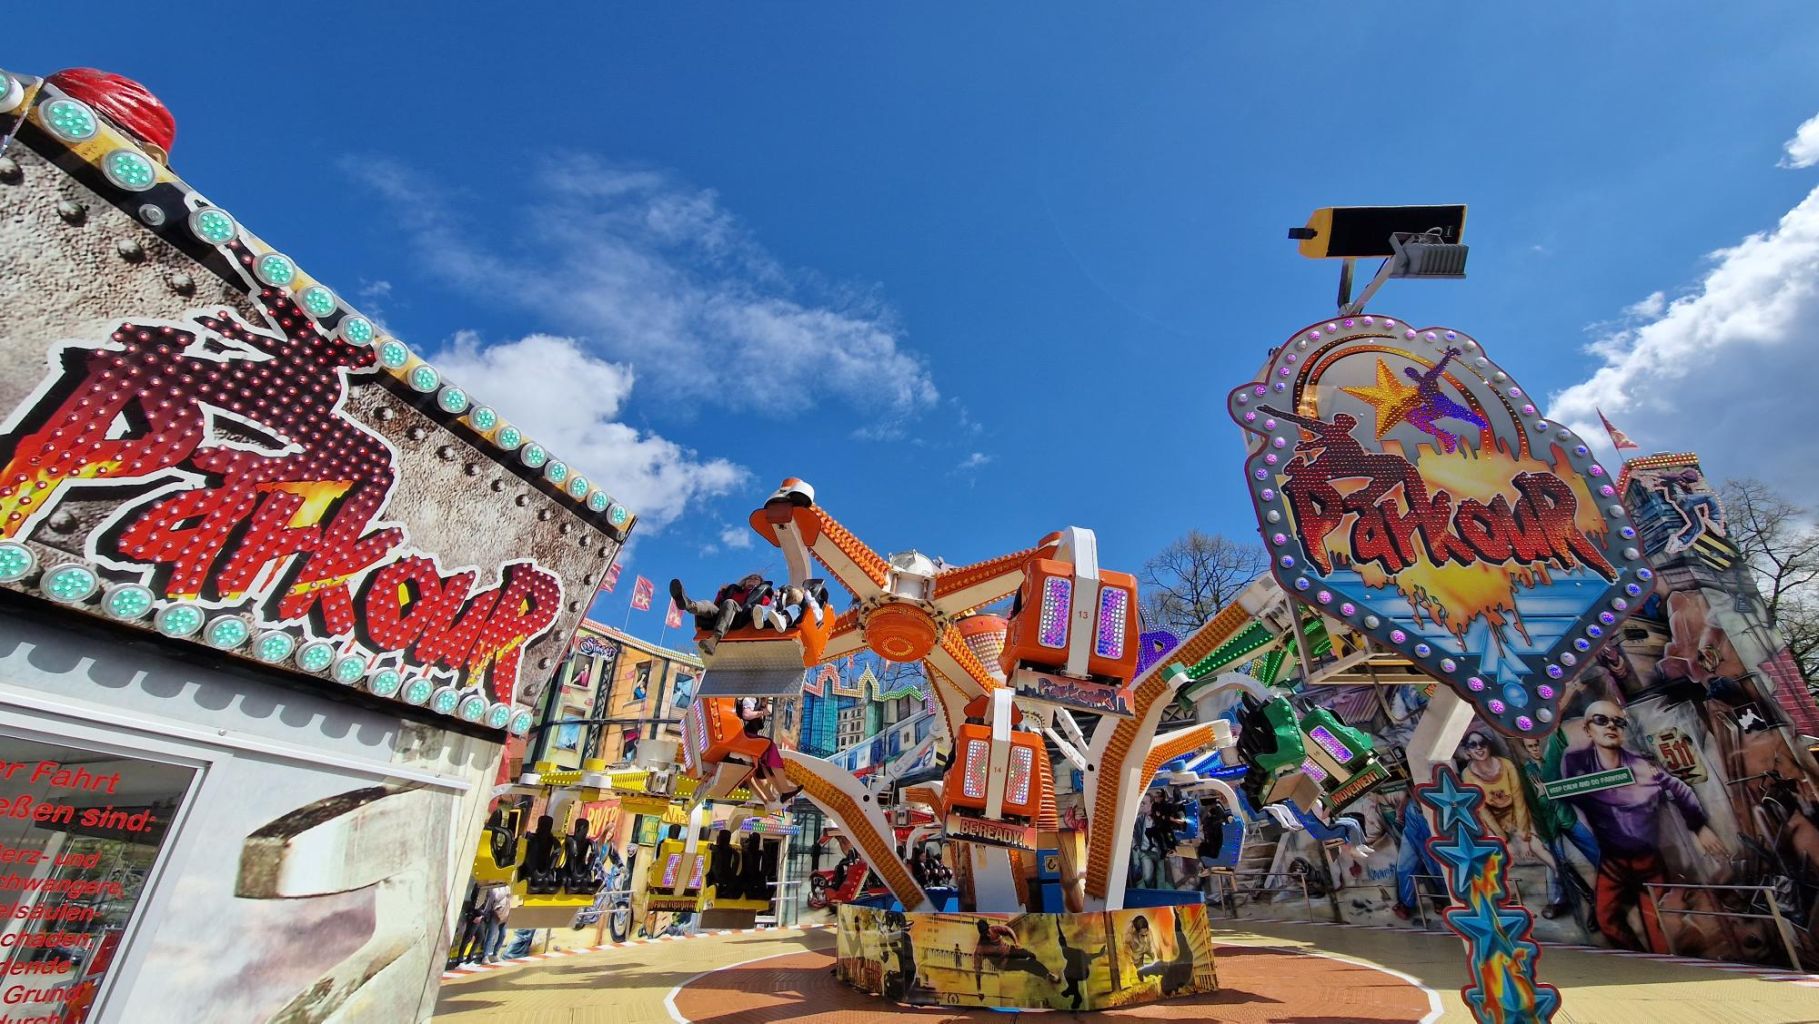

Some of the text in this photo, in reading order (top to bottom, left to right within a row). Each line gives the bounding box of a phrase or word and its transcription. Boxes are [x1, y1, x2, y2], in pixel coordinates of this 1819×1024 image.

[1078, 610, 1089, 620] 13
[30, 760, 120, 795] Fahrt
[1330, 770, 1380, 807] MOVEMENT
[1579, 780, 1590, 788] AND
[80, 804, 157, 832] sind:
[960, 820, 979, 836] BE
[0, 842, 102, 869] erz- und
[3, 983, 85, 1005] Grund
